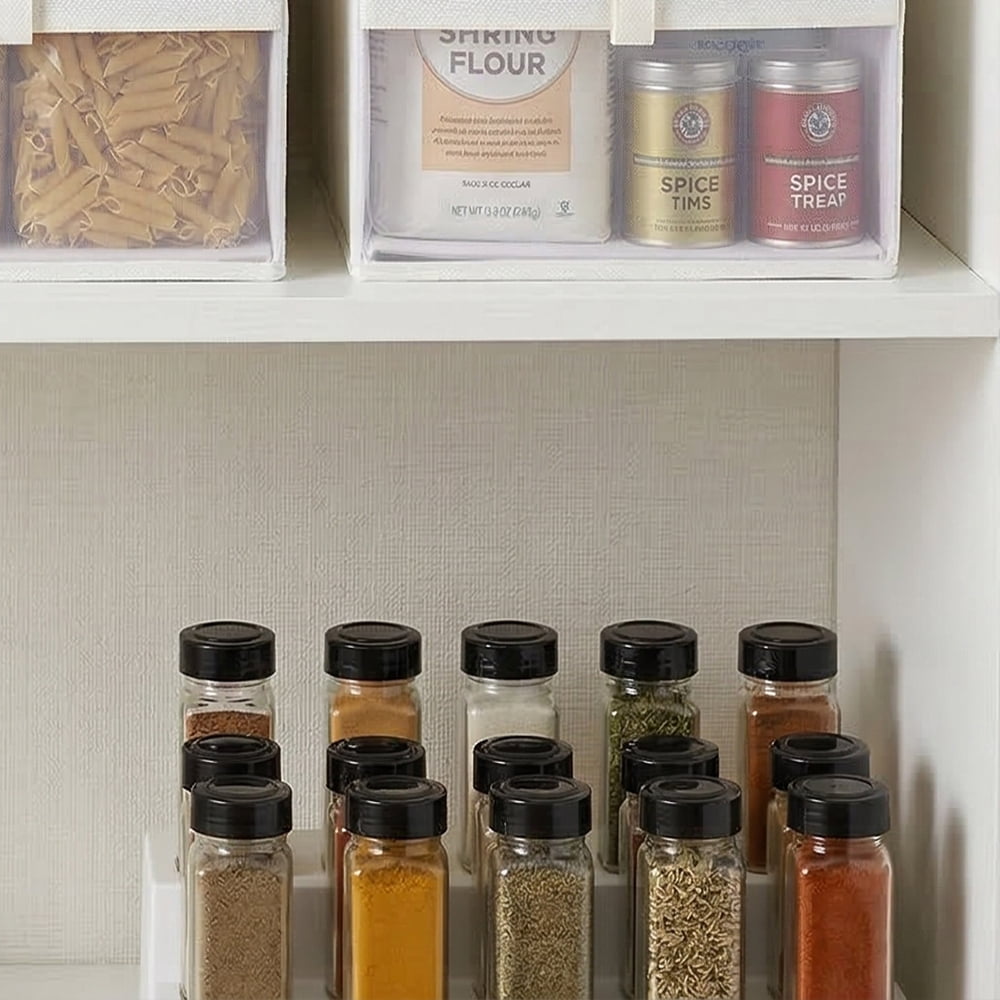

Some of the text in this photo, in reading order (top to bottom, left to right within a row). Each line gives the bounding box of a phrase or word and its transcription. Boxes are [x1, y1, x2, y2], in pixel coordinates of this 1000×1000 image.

[450, 51, 546, 75] FLOUR
[661, 175, 720, 193] SPICE
[790, 172, 848, 191] SPICE
[671, 195, 711, 211] TIMS
